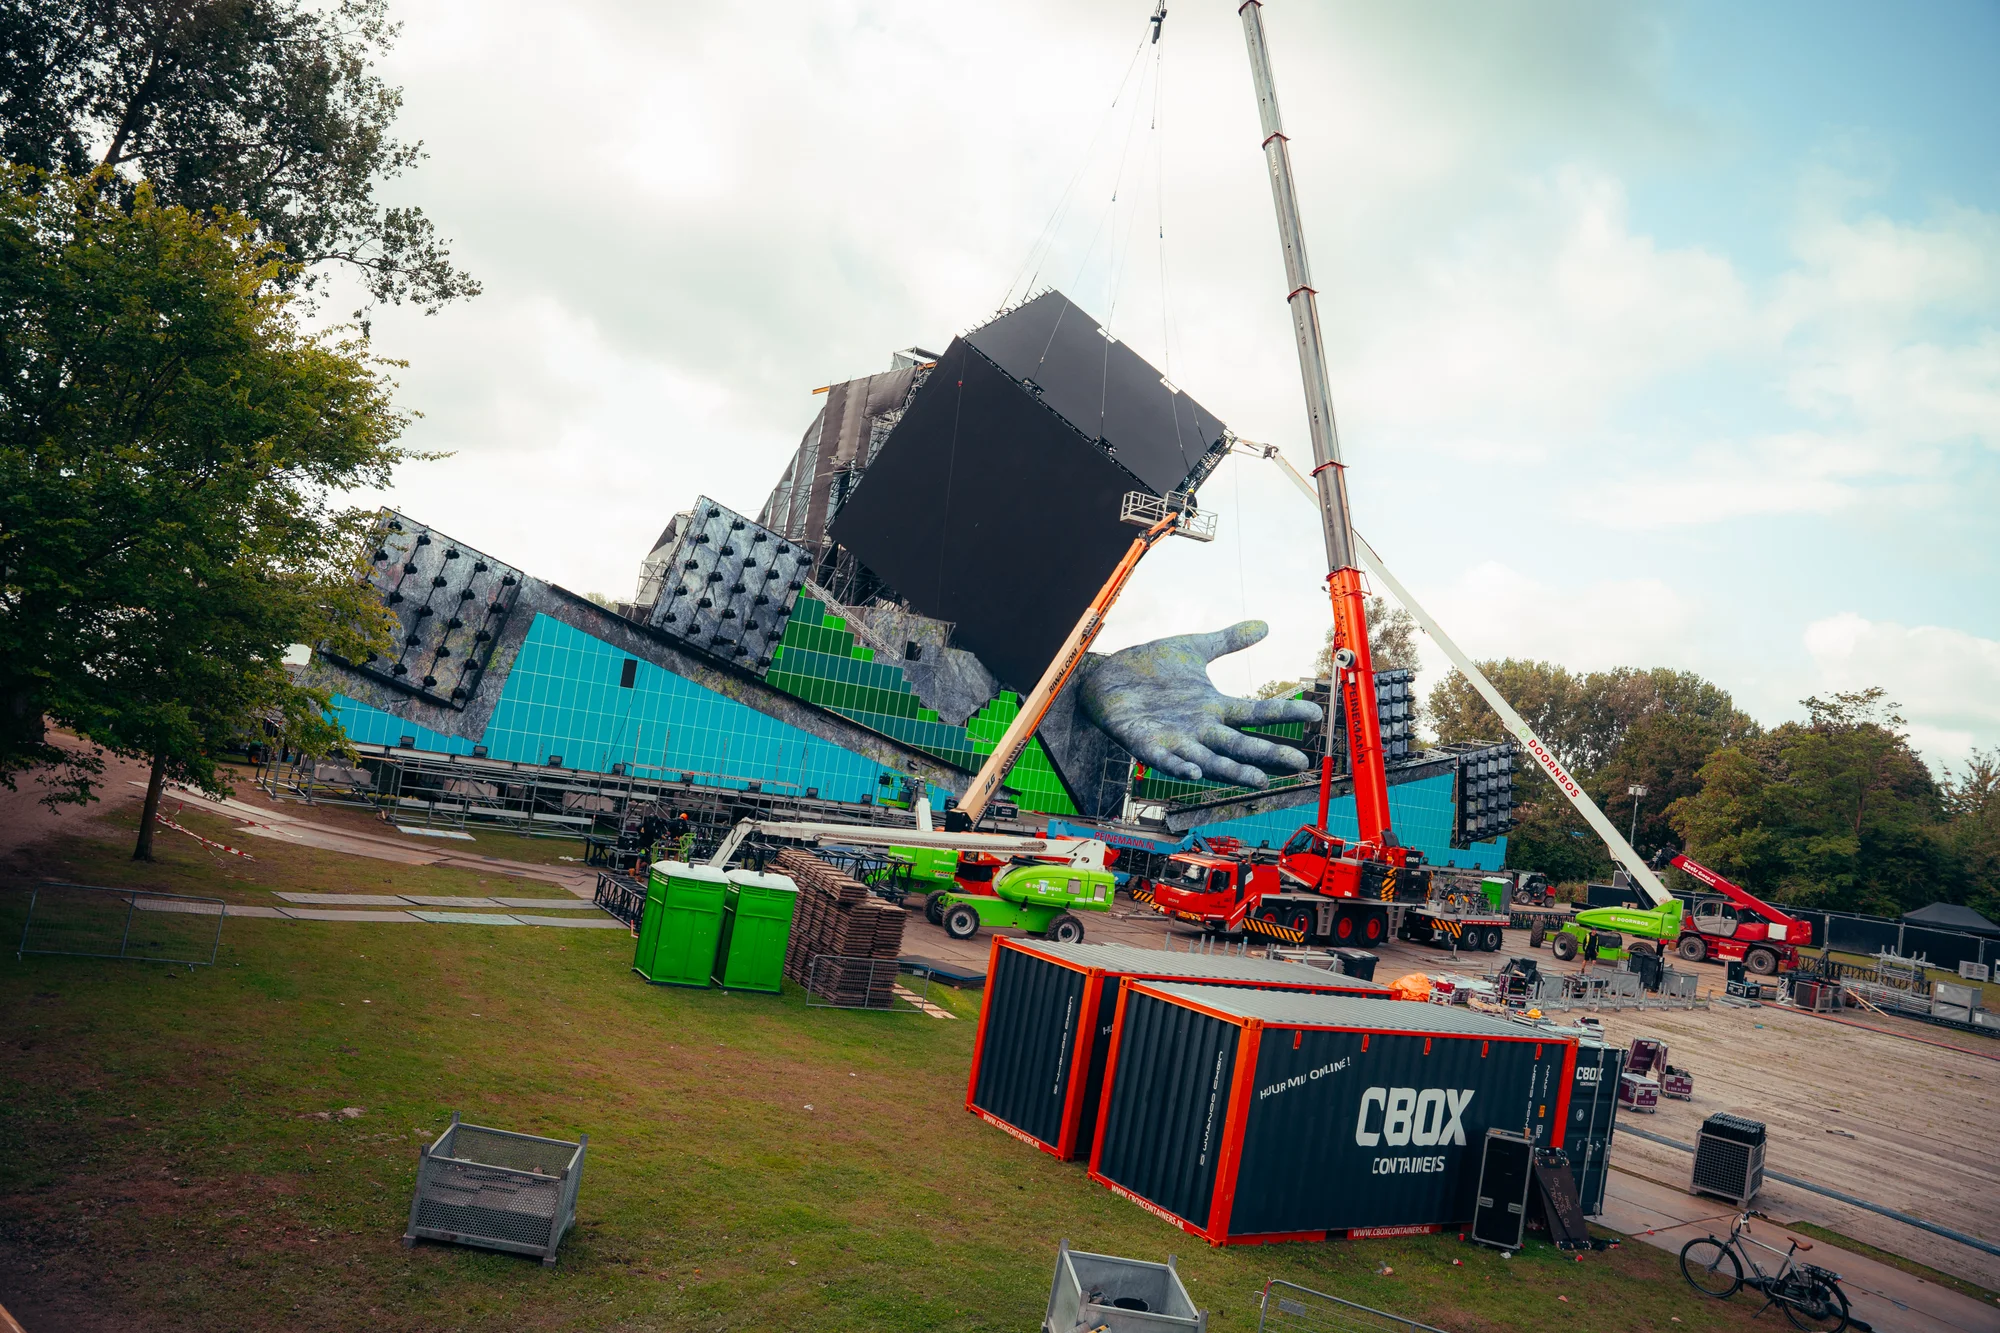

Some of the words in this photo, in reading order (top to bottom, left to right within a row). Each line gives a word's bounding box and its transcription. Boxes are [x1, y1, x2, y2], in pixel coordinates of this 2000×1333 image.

[1049, 648, 1078, 694] RIWAL.COM
[1348, 683, 1366, 765] PEINEMANN
[1527, 739, 1580, 798] DOORNBOS
[985, 773, 995, 795] JLG
[1094, 831, 1156, 851] PEINEMANN.NL
[1032, 883, 1062, 892] DONBOS
[1616, 917, 1649, 927] DOORNBOS
[1576, 1066, 1604, 1081] CBOX
[1260, 1082, 1286, 1100] HUUR
[1203, 1093, 1216, 1151] 002453
[1356, 1087, 1476, 1147] CBOX
[1372, 1156, 1445, 1175] CONTAINERS
[1111, 1184, 1184, 1231] WWW.CBOXCONTAINERS.NL
[1353, 1226, 1430, 1237] WWW.CBOXCONTAINERS.NL
